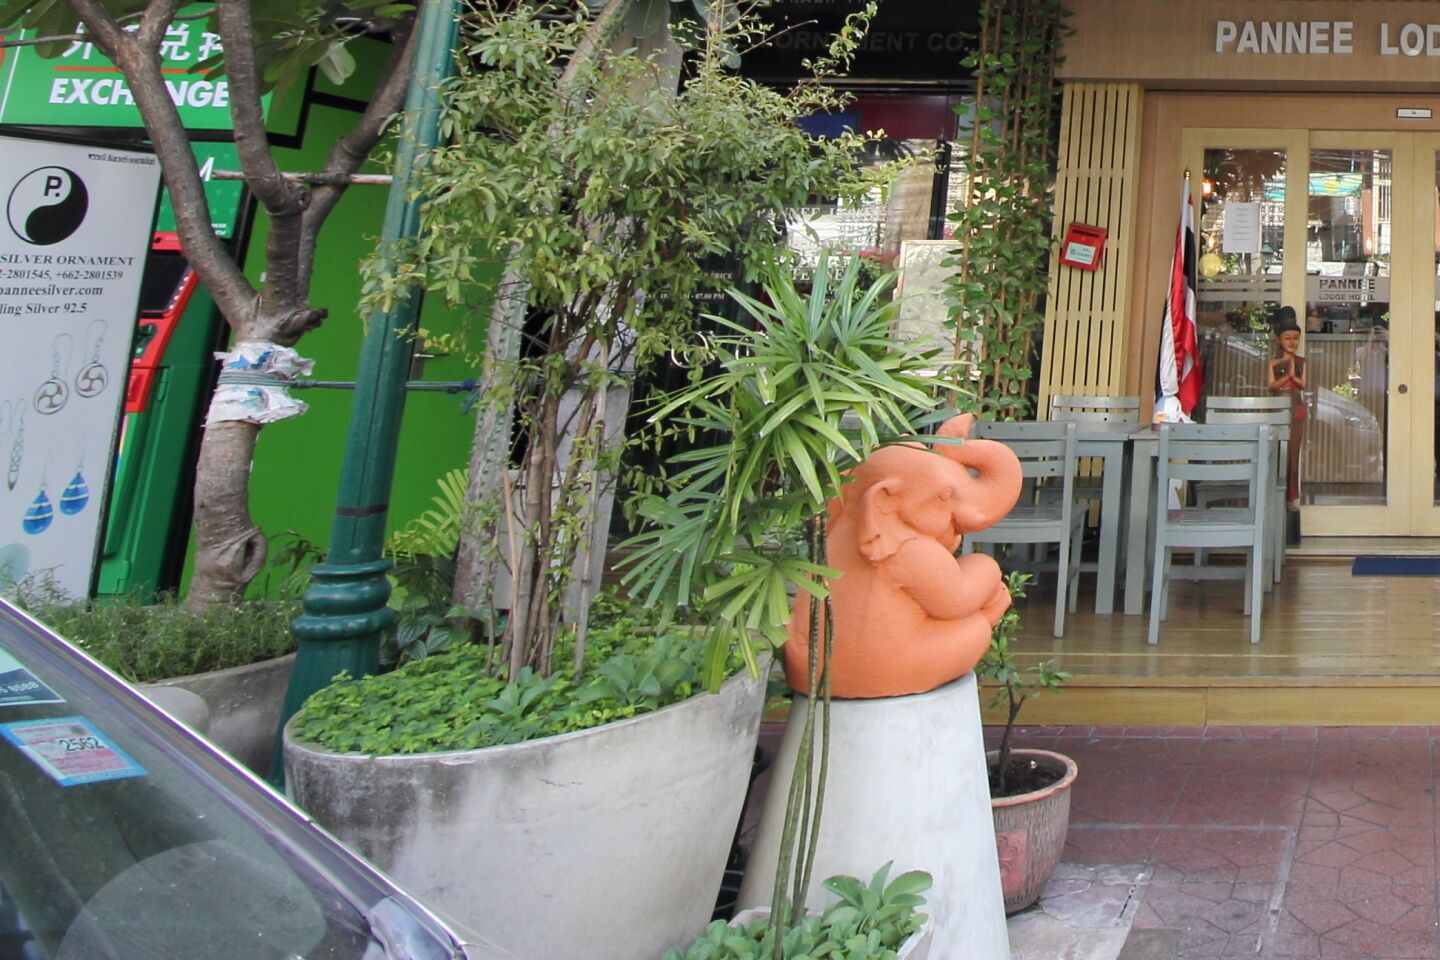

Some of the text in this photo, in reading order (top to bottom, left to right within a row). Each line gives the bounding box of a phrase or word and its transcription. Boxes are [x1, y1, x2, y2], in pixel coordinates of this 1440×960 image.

[776, 30, 922, 52] ORNENT
[1214, 20, 1354, 55] PANNEE
[48, 78, 229, 108] EXCHNGE
[56, 254, 136, 266] ORNAMENT
[25, 302, 60, 315] Silver
[63, 302, 88, 314] 92.5
